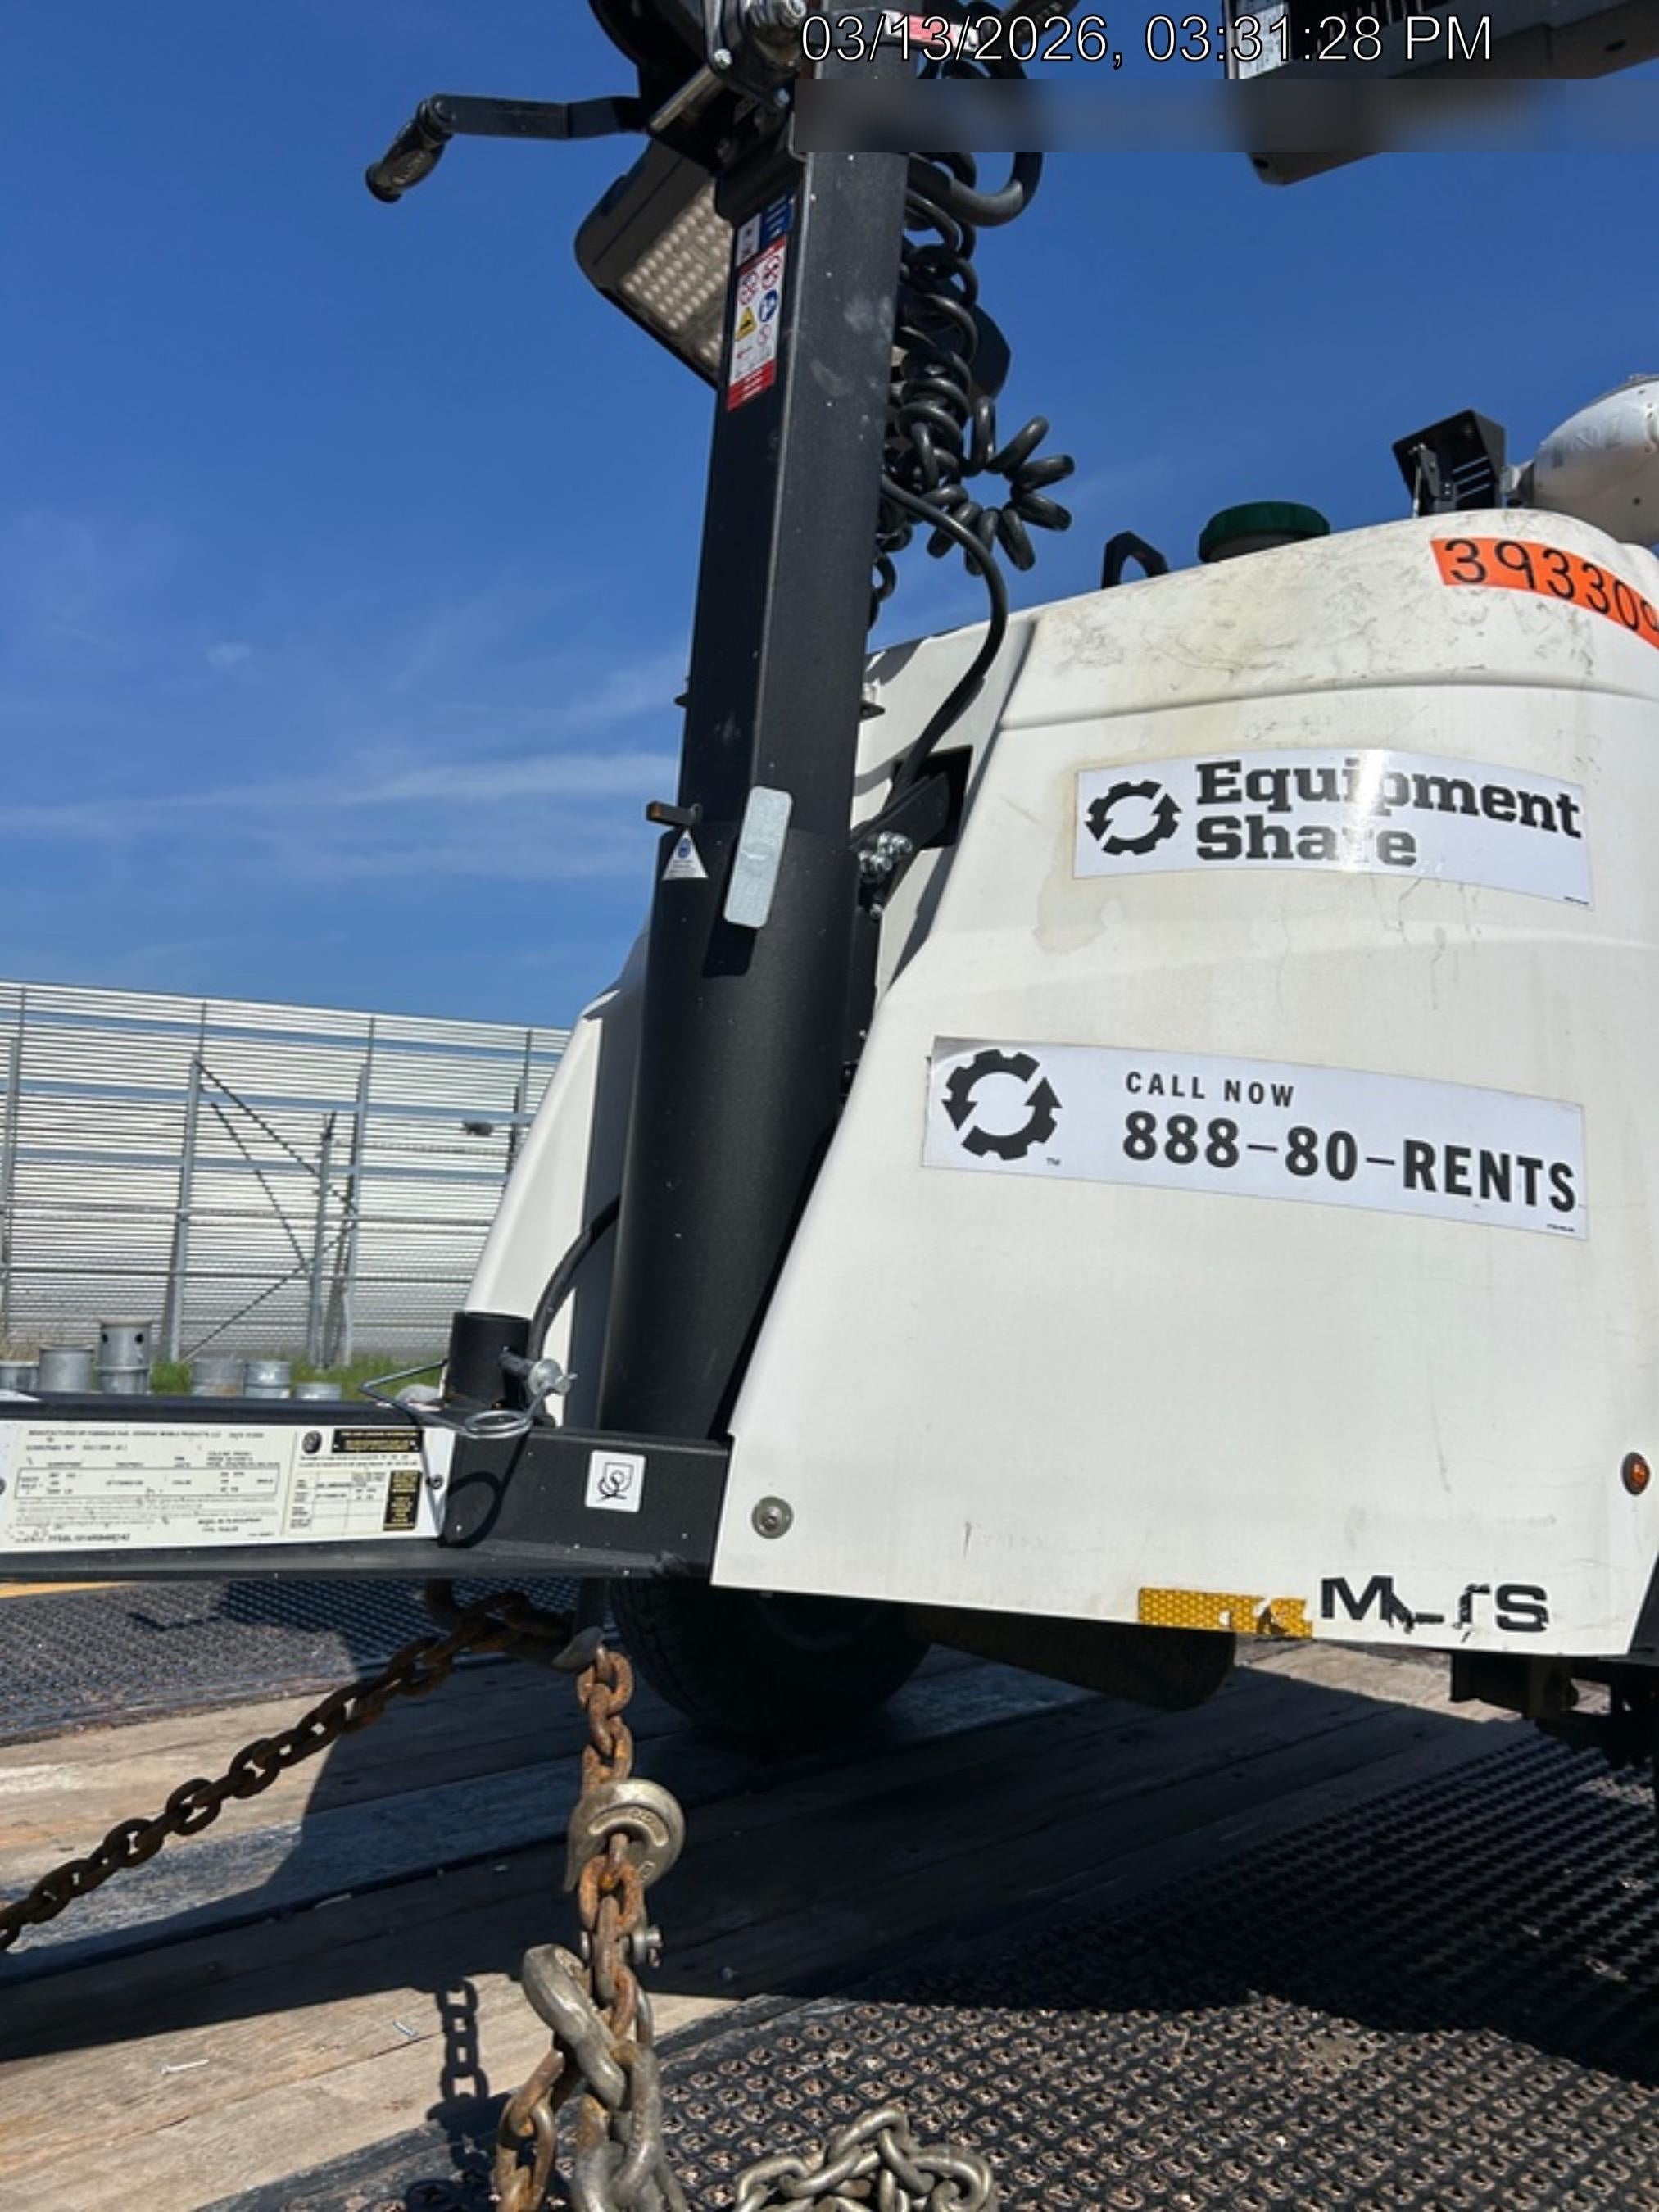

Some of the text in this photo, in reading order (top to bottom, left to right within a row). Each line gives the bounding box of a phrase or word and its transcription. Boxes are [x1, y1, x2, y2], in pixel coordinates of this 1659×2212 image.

[1196, 759, 1583, 838] Equipment
[1196, 814, 1417, 866] Shae
[1126, 1071, 1295, 1108] CALL NOW
[1123, 1109, 1576, 1213] 888-80-RENTS
